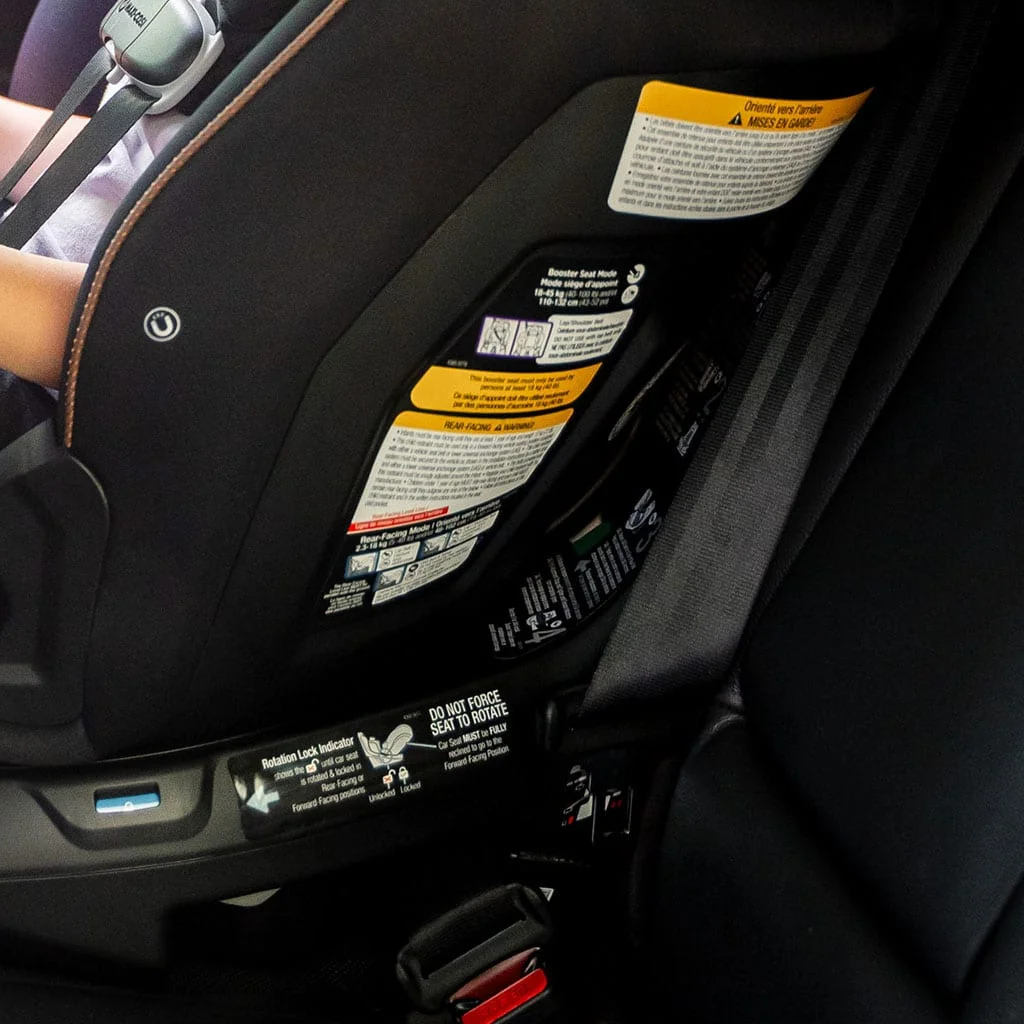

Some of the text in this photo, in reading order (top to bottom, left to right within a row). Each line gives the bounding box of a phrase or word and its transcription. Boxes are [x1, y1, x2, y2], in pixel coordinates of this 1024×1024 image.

[744, 100, 776, 114] Orienté
[777, 105, 795, 115] vers
[748, 116, 776, 128] MISES
[776, 117, 788, 128] EN
[540, 278, 619, 289] Mode siège d'appoint
[547, 267, 618, 278] Booster Seat Mode
[444, 421, 492, 432] REAR-FACING
[360, 530, 408, 545] Rear-Facing
[408, 523, 431, 536] Mode
[429, 706, 445, 721] DO
[445, 698, 468, 717] NOT
[467, 689, 502, 710] FORCE
[430, 702, 509, 736] SEAT TO ROTATE
[438, 722, 507, 750] Car Seat MUST be FULLY
[261, 736, 354, 769] Rotation Lock Indicator
[448, 746, 471, 759] reclined
[471, 744, 478, 752] to
[478, 742, 486, 752] go
[493, 736, 503, 745] the
[487, 745, 510, 758] Position
[274, 750, 359, 781] shows the until car seat
[300, 762, 362, 786] is rotated & locked in
[357, 774, 365, 782] or
[339, 786, 366, 801] positions
[368, 780, 421, 803] Unlocked Locked
